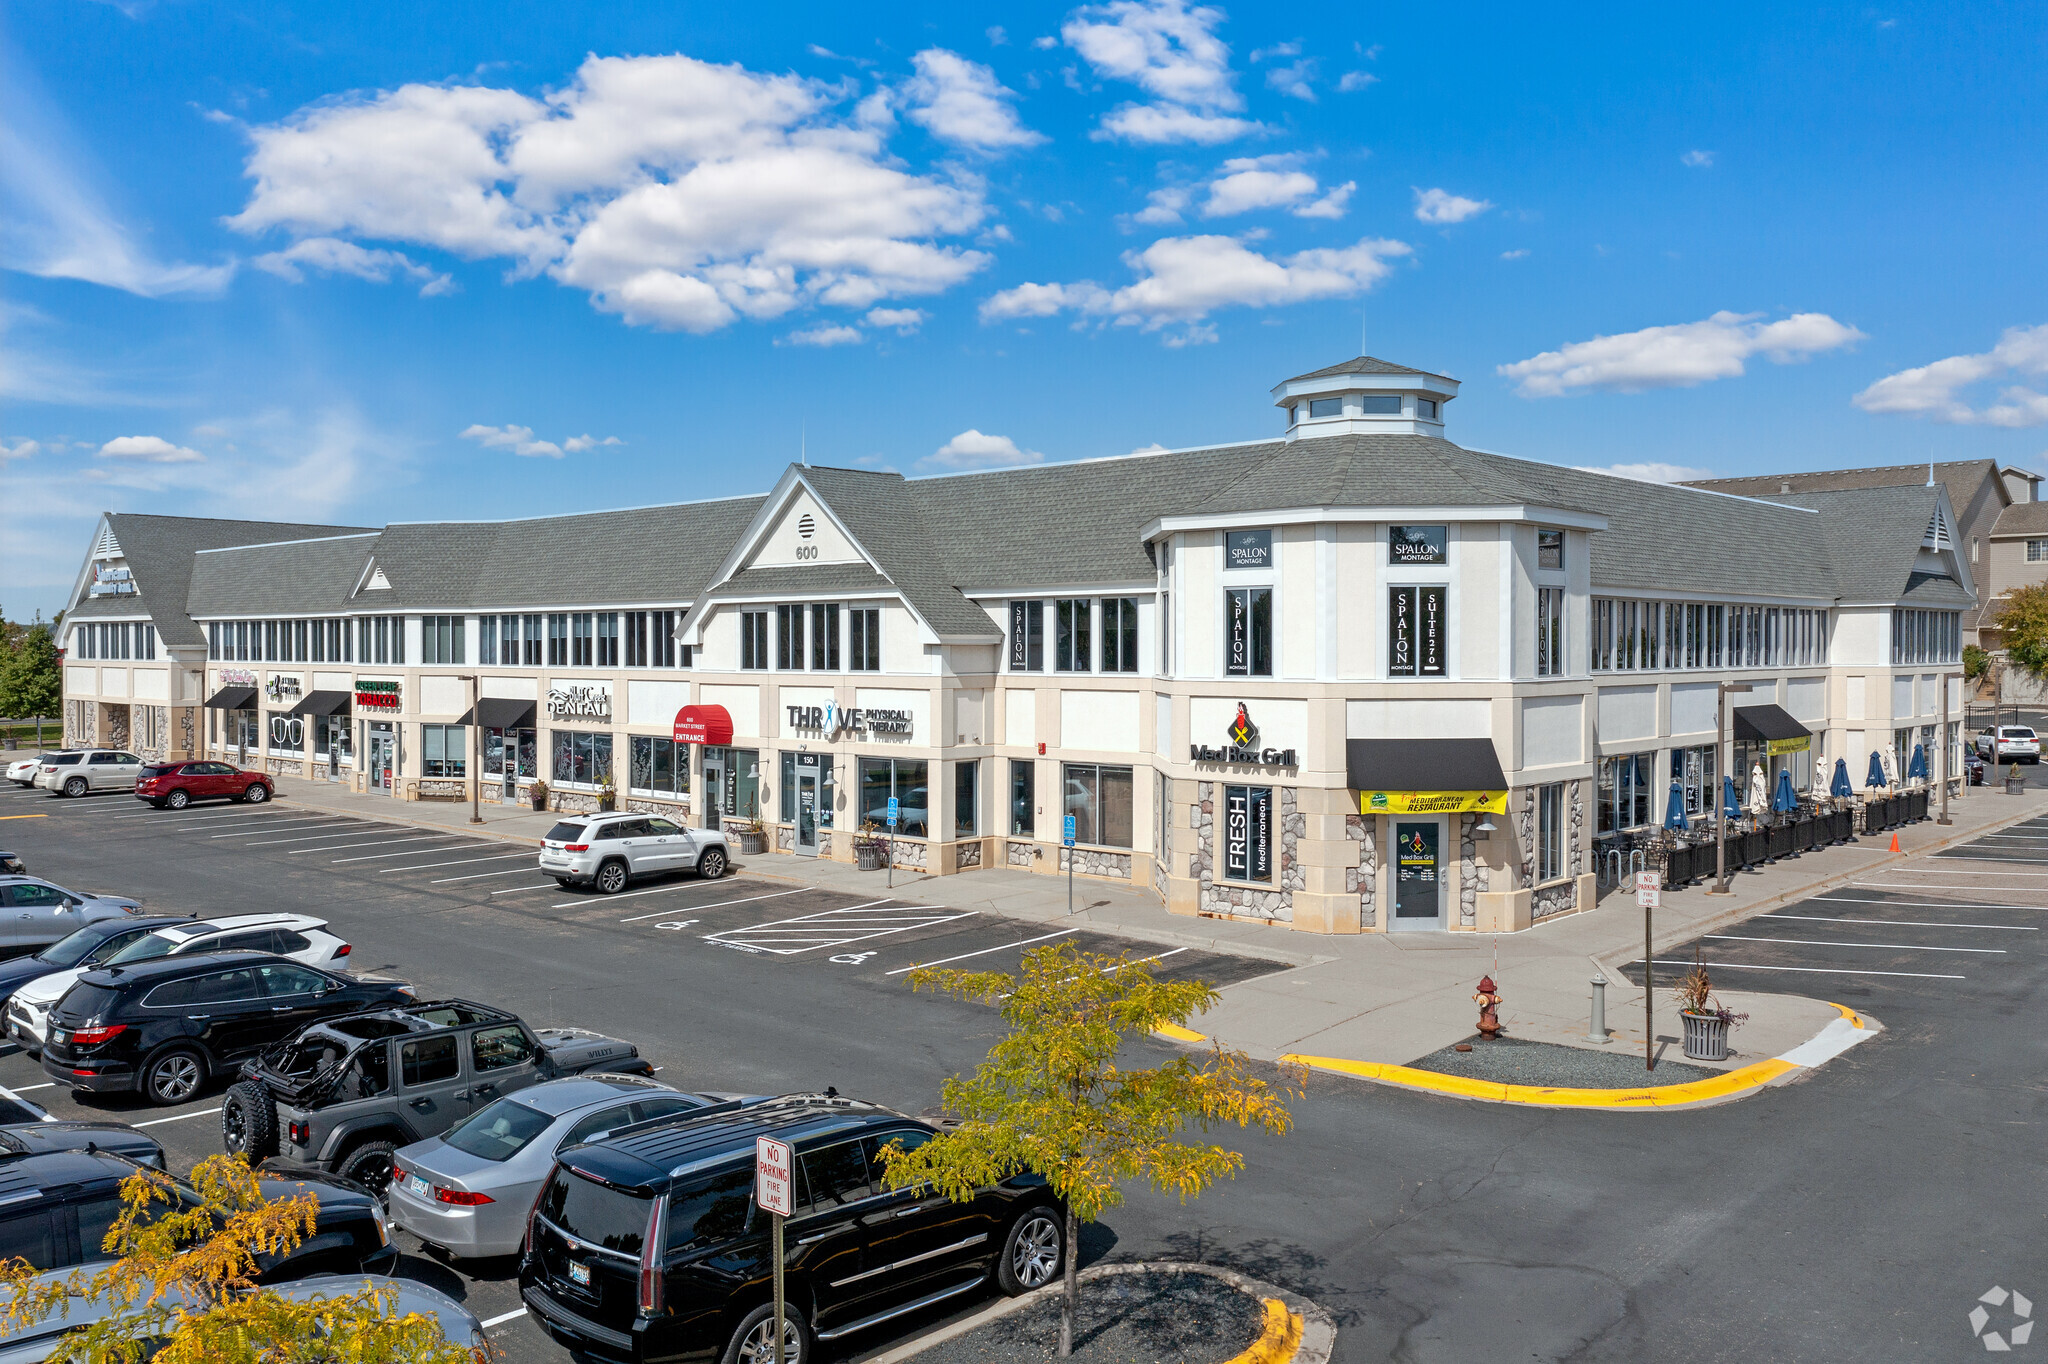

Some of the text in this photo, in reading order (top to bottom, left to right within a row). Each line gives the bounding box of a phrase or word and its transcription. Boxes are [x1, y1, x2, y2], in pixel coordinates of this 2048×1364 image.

[796, 545, 818, 560] 600
[1232, 548, 1267, 559] SPALON
[1396, 543, 1439, 554] SPALON
[1428, 594, 1436, 638] SUITE
[1233, 596, 1243, 664] SPALON
[1396, 594, 1408, 664] SPALON
[355, 680, 399, 692] GREEN LEAF
[355, 693, 400, 708] TOBACCO
[547, 700, 608, 717] DENTAL
[866, 708, 908, 720] PHYSICAL
[866, 721, 908, 732] THERAPY
[675, 733, 705, 742] ENTRANCE
[1190, 744, 1297, 766] Med Box Grill
[1407, 802, 1462, 811] RESTAURANT
[1230, 796, 1246, 868] FRESH
[767, 1147, 779, 1162] NO
[760, 1161, 787, 1182] PARKING
[767, 1180, 780, 1193] FIRE
[766, 1193, 782, 1206] LANE
